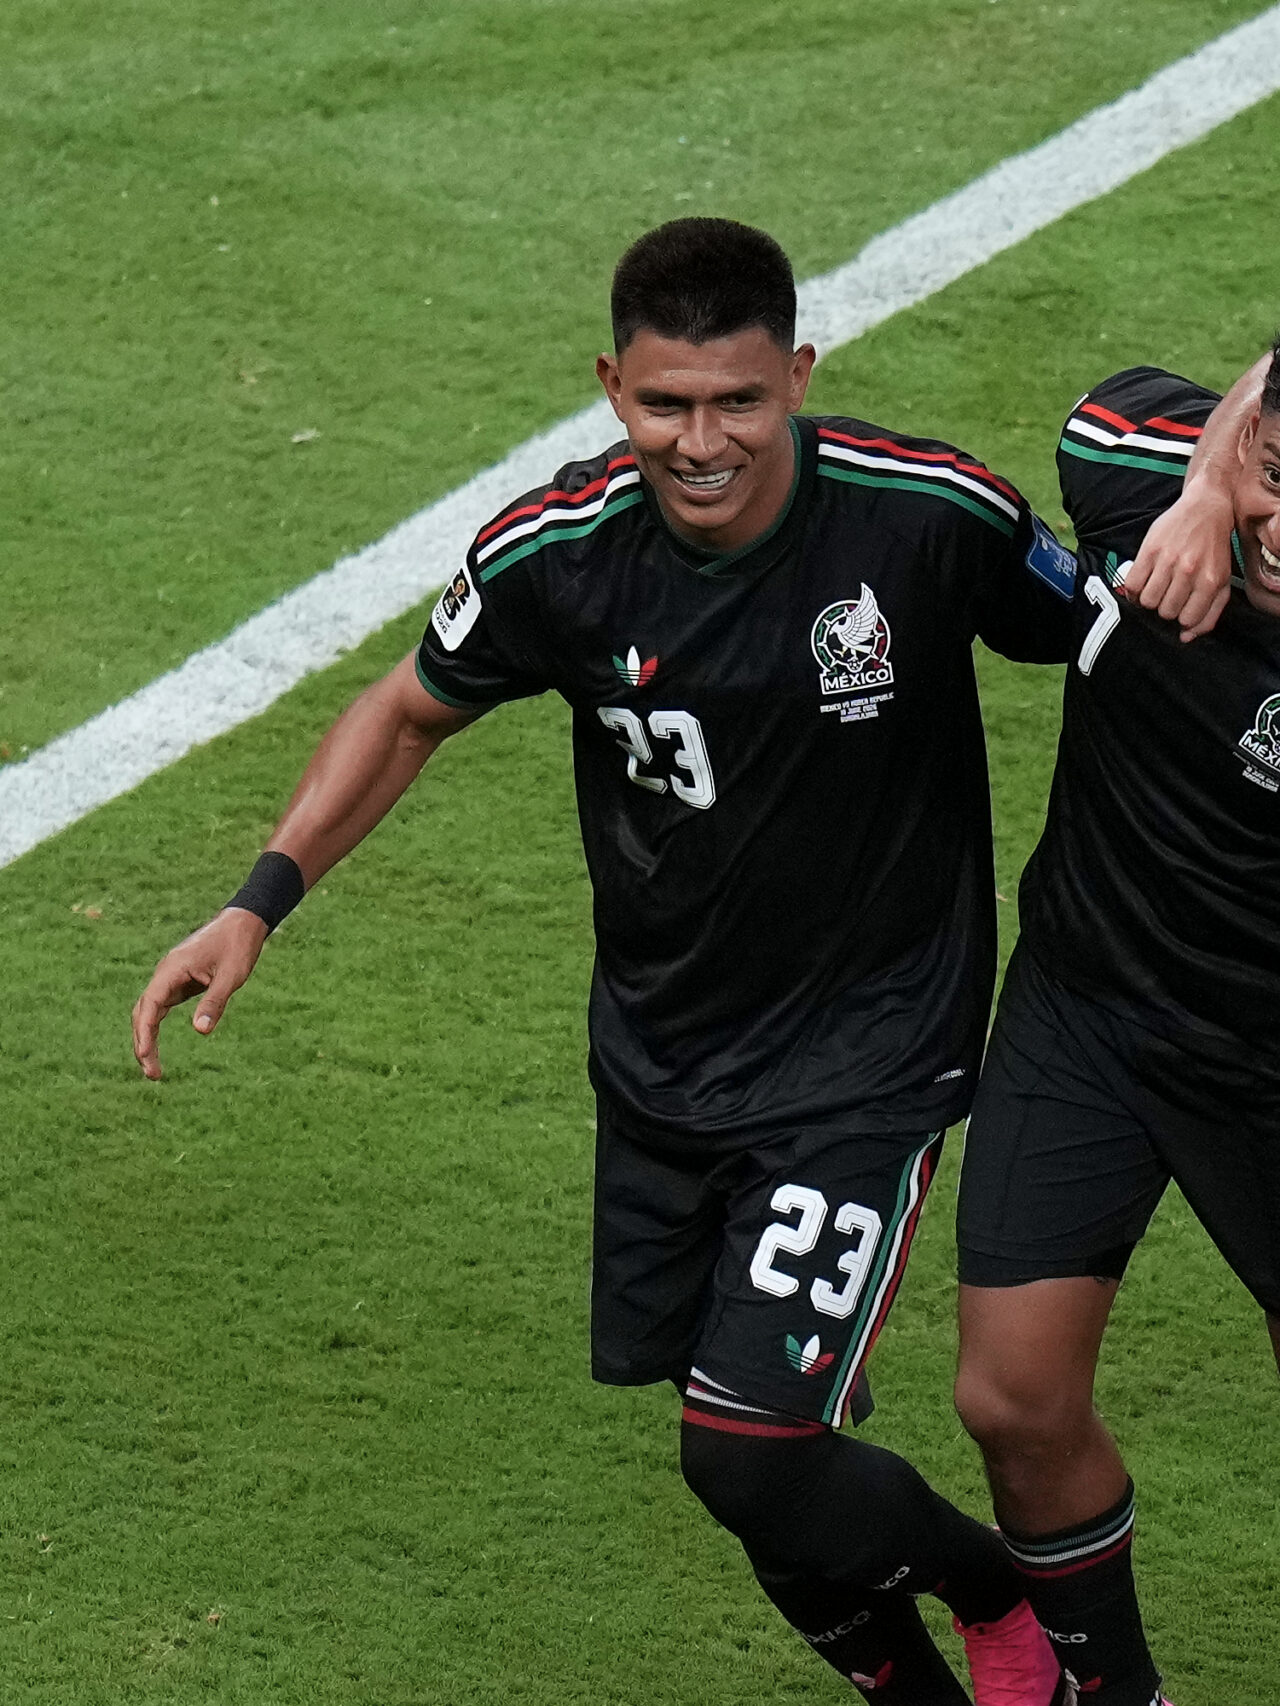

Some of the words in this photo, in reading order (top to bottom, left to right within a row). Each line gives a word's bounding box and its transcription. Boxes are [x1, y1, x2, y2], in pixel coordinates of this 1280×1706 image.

[1078, 575, 1121, 676] 7
[824, 668, 889, 690] MÉXICO
[597, 707, 716, 809] 23
[750, 1184, 881, 1319] 23
